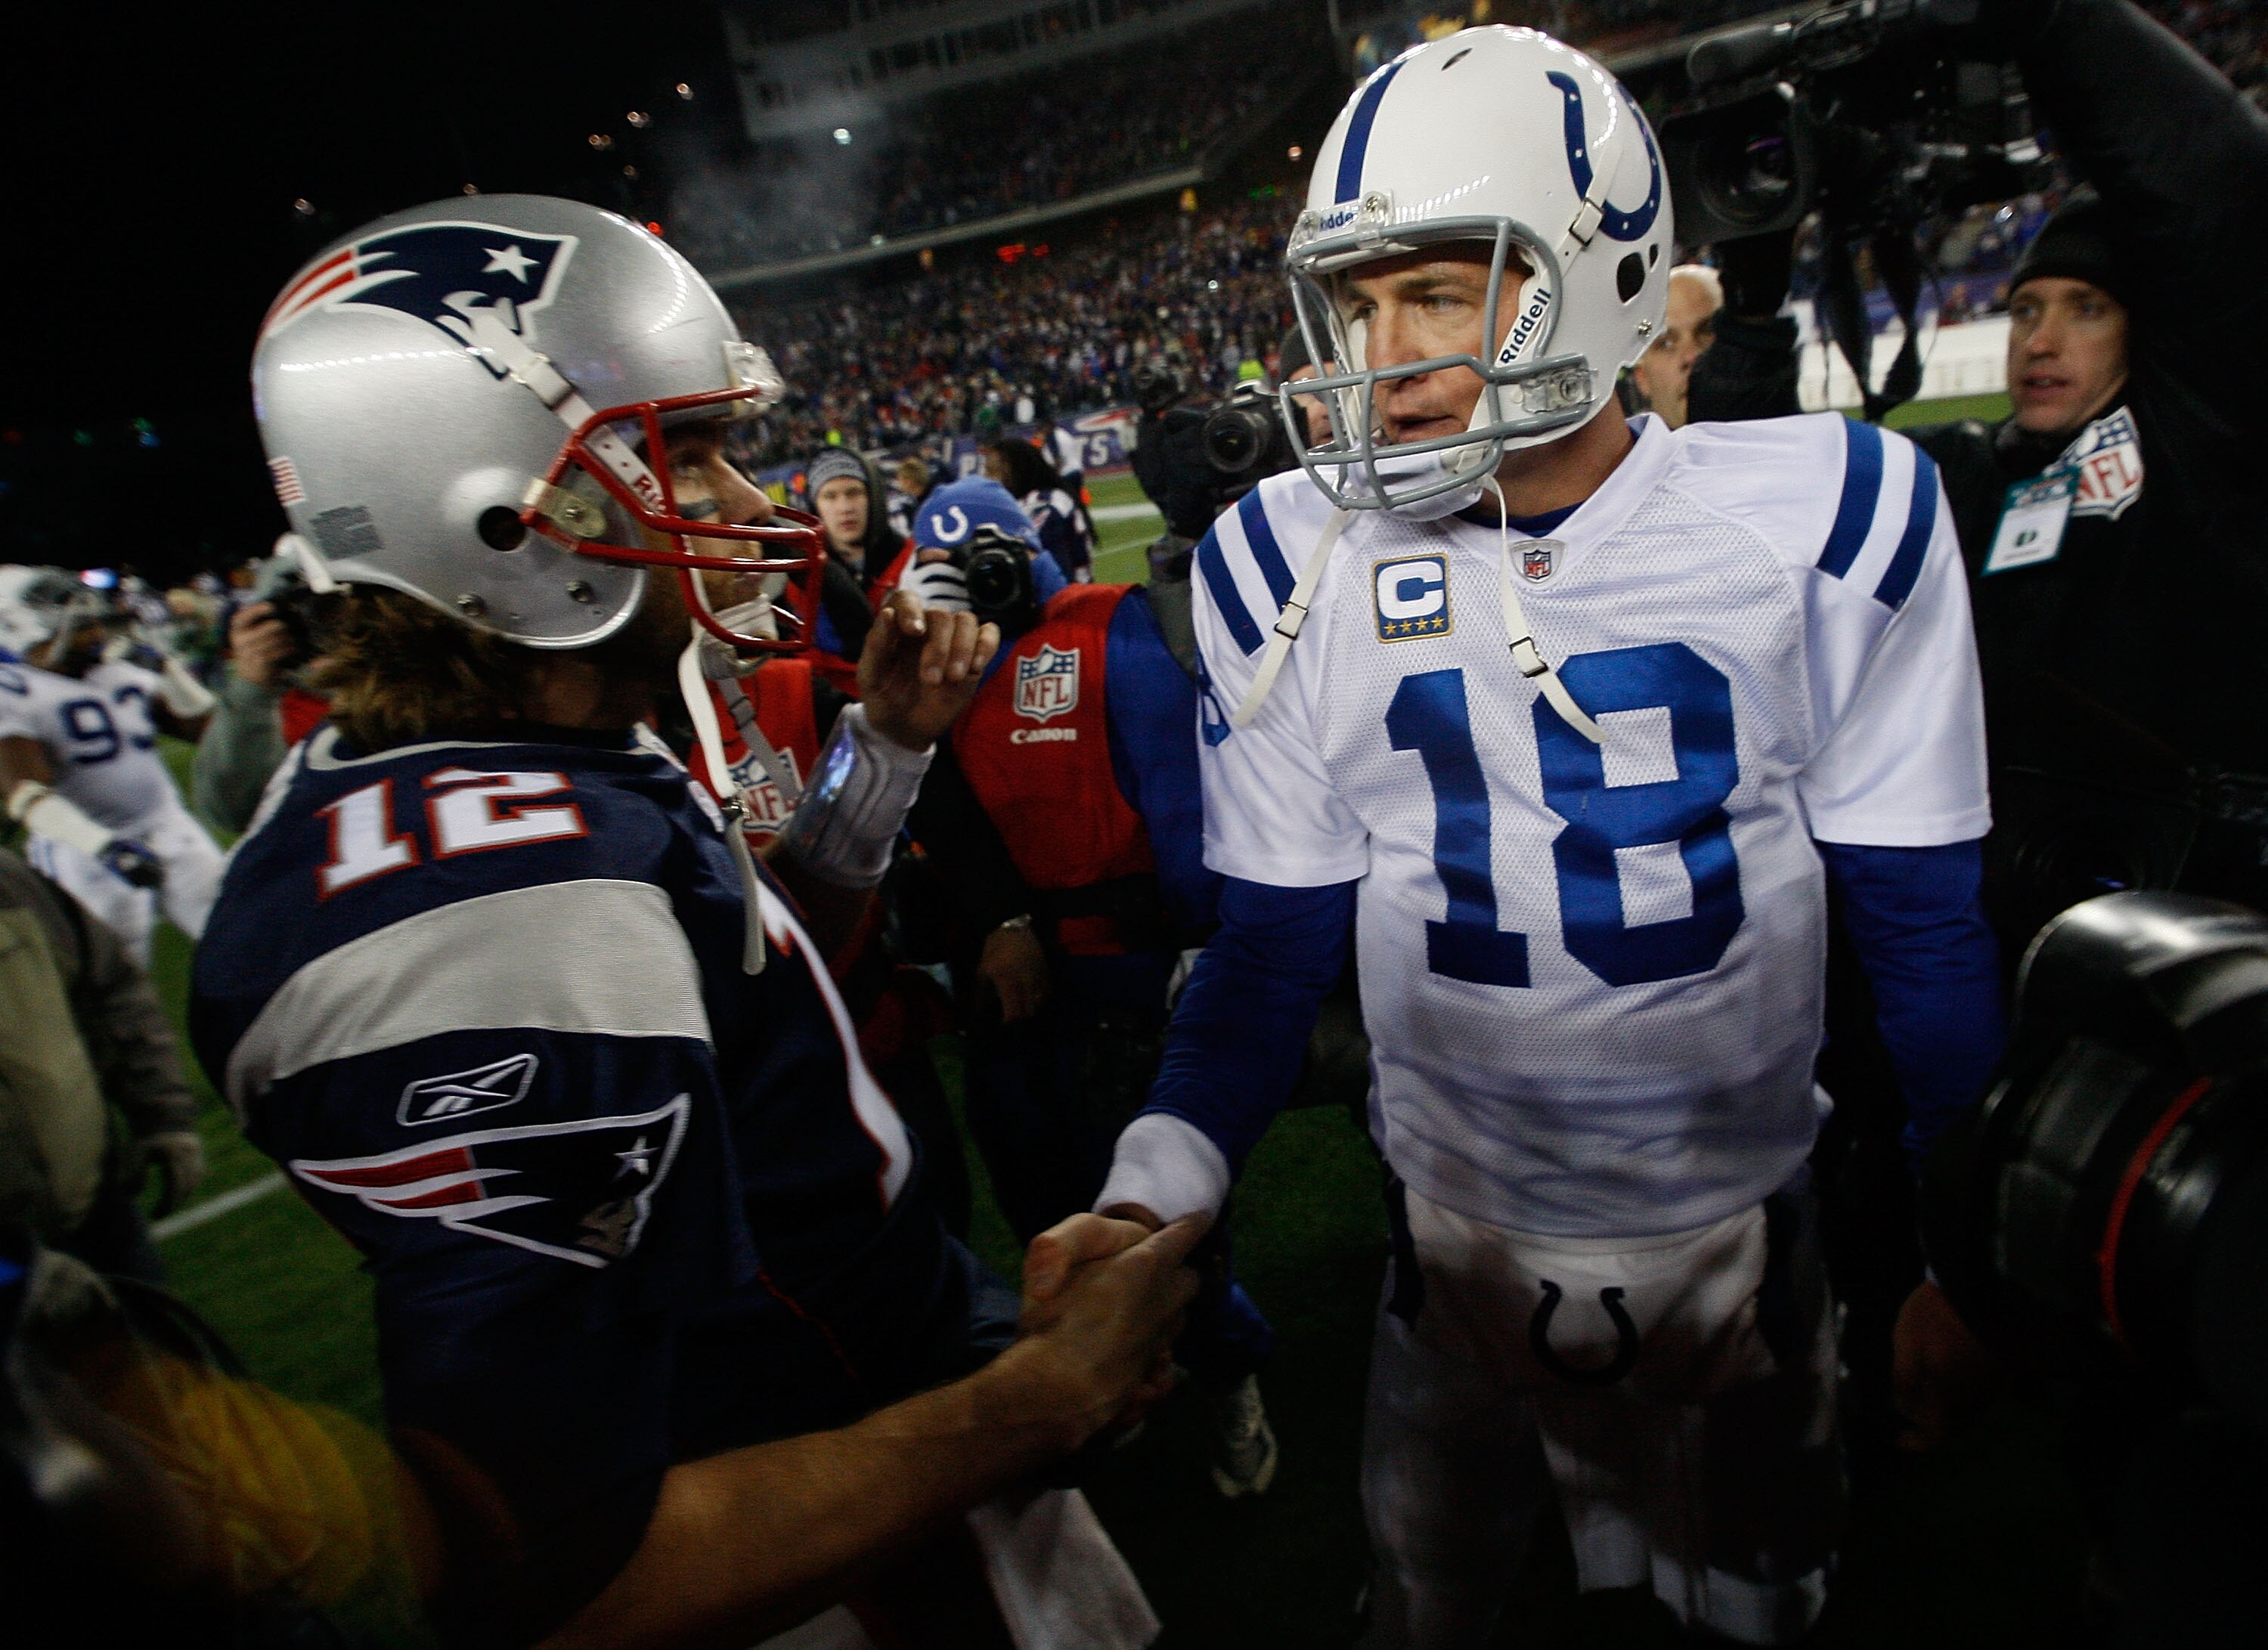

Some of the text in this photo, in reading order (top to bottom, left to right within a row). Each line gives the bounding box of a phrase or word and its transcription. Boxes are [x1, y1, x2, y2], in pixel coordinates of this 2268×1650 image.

[1500, 288, 1551, 364] Riddell
[1377, 561, 1445, 619] C
[1023, 676, 1070, 708] NFL
[1010, 727, 1077, 745] Canon
[315, 765, 590, 902] 12
[1385, 642, 1747, 989] 18
